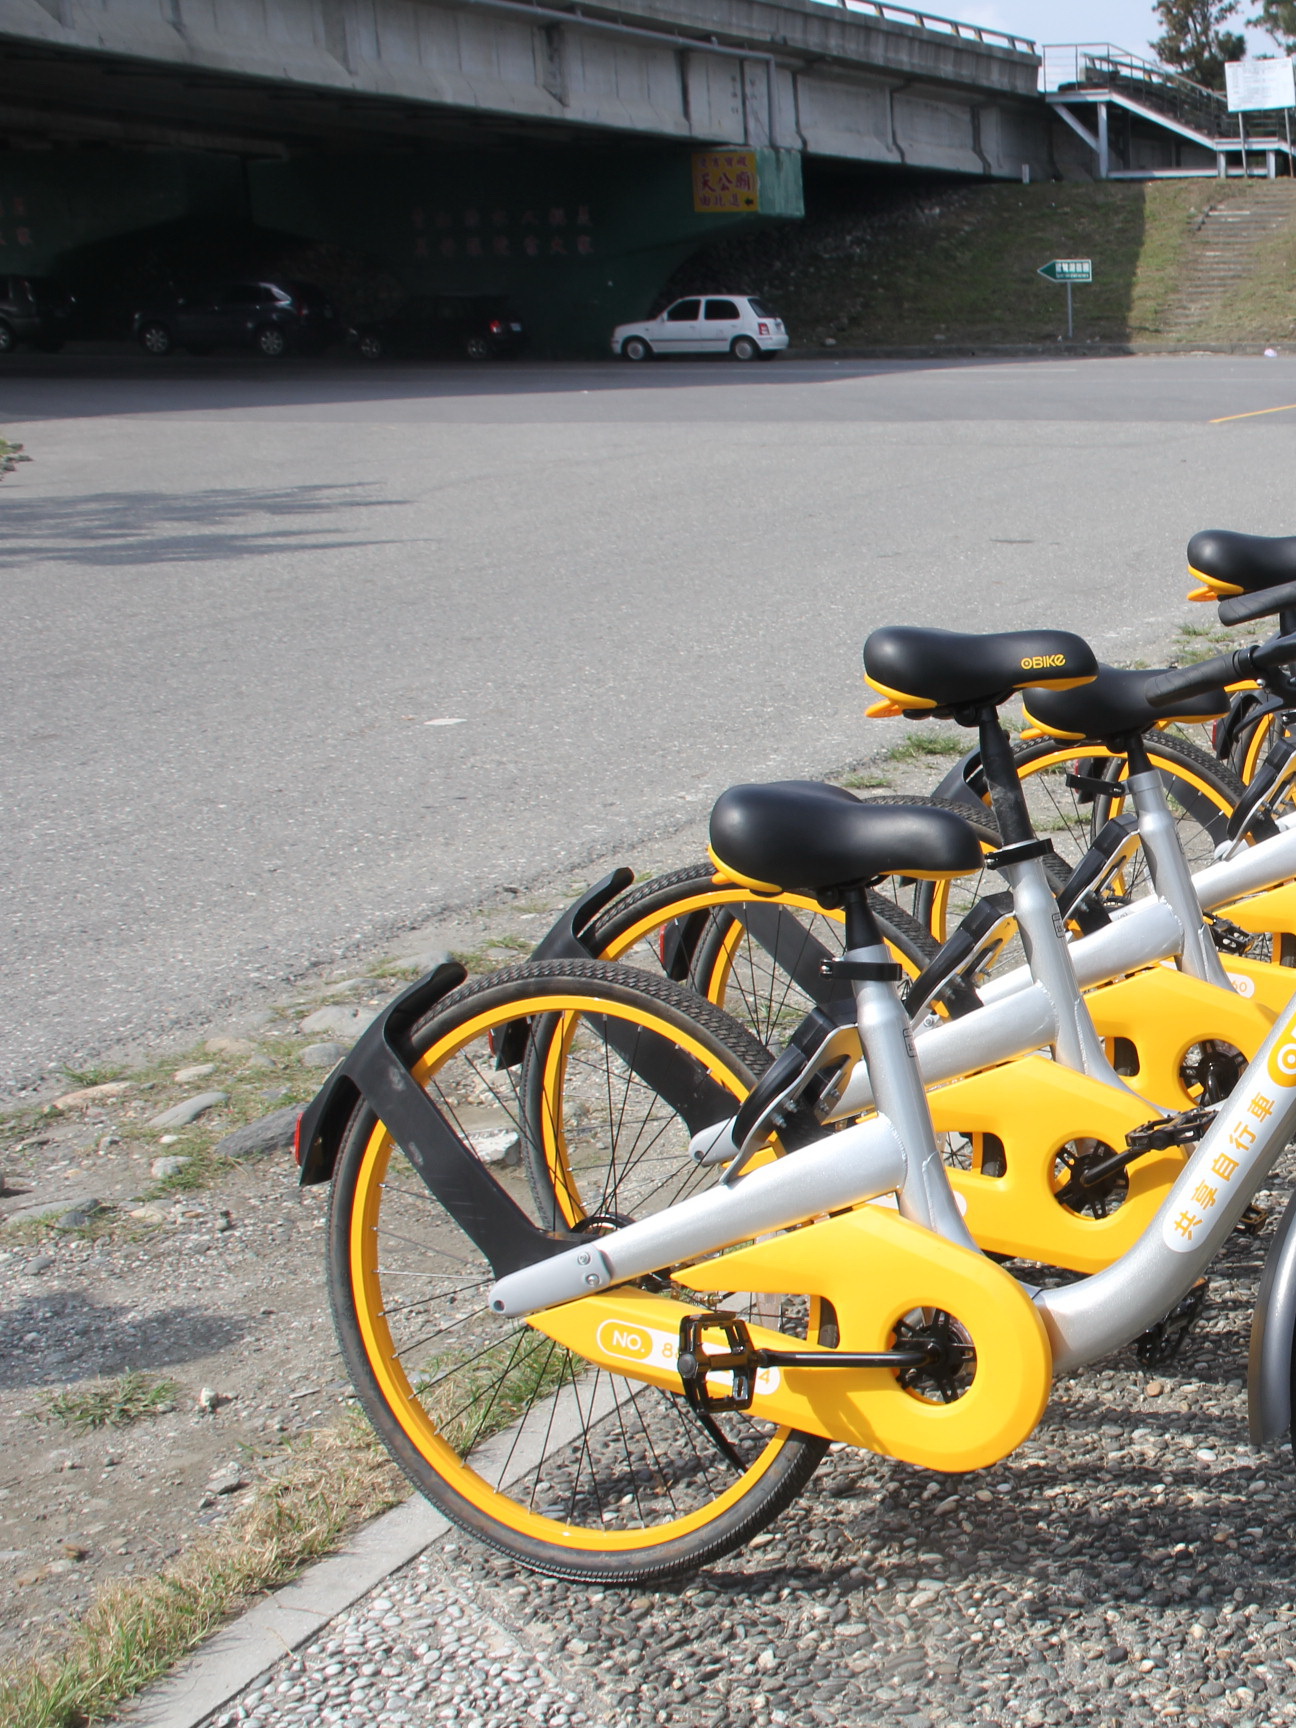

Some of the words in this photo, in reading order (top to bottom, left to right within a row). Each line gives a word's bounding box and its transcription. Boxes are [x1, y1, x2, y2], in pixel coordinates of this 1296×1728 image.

[699, 171, 752, 192] 天公廟
[1173, 1091, 1276, 1241] 共享自行車
[612, 1329, 646, 1354] NO.
